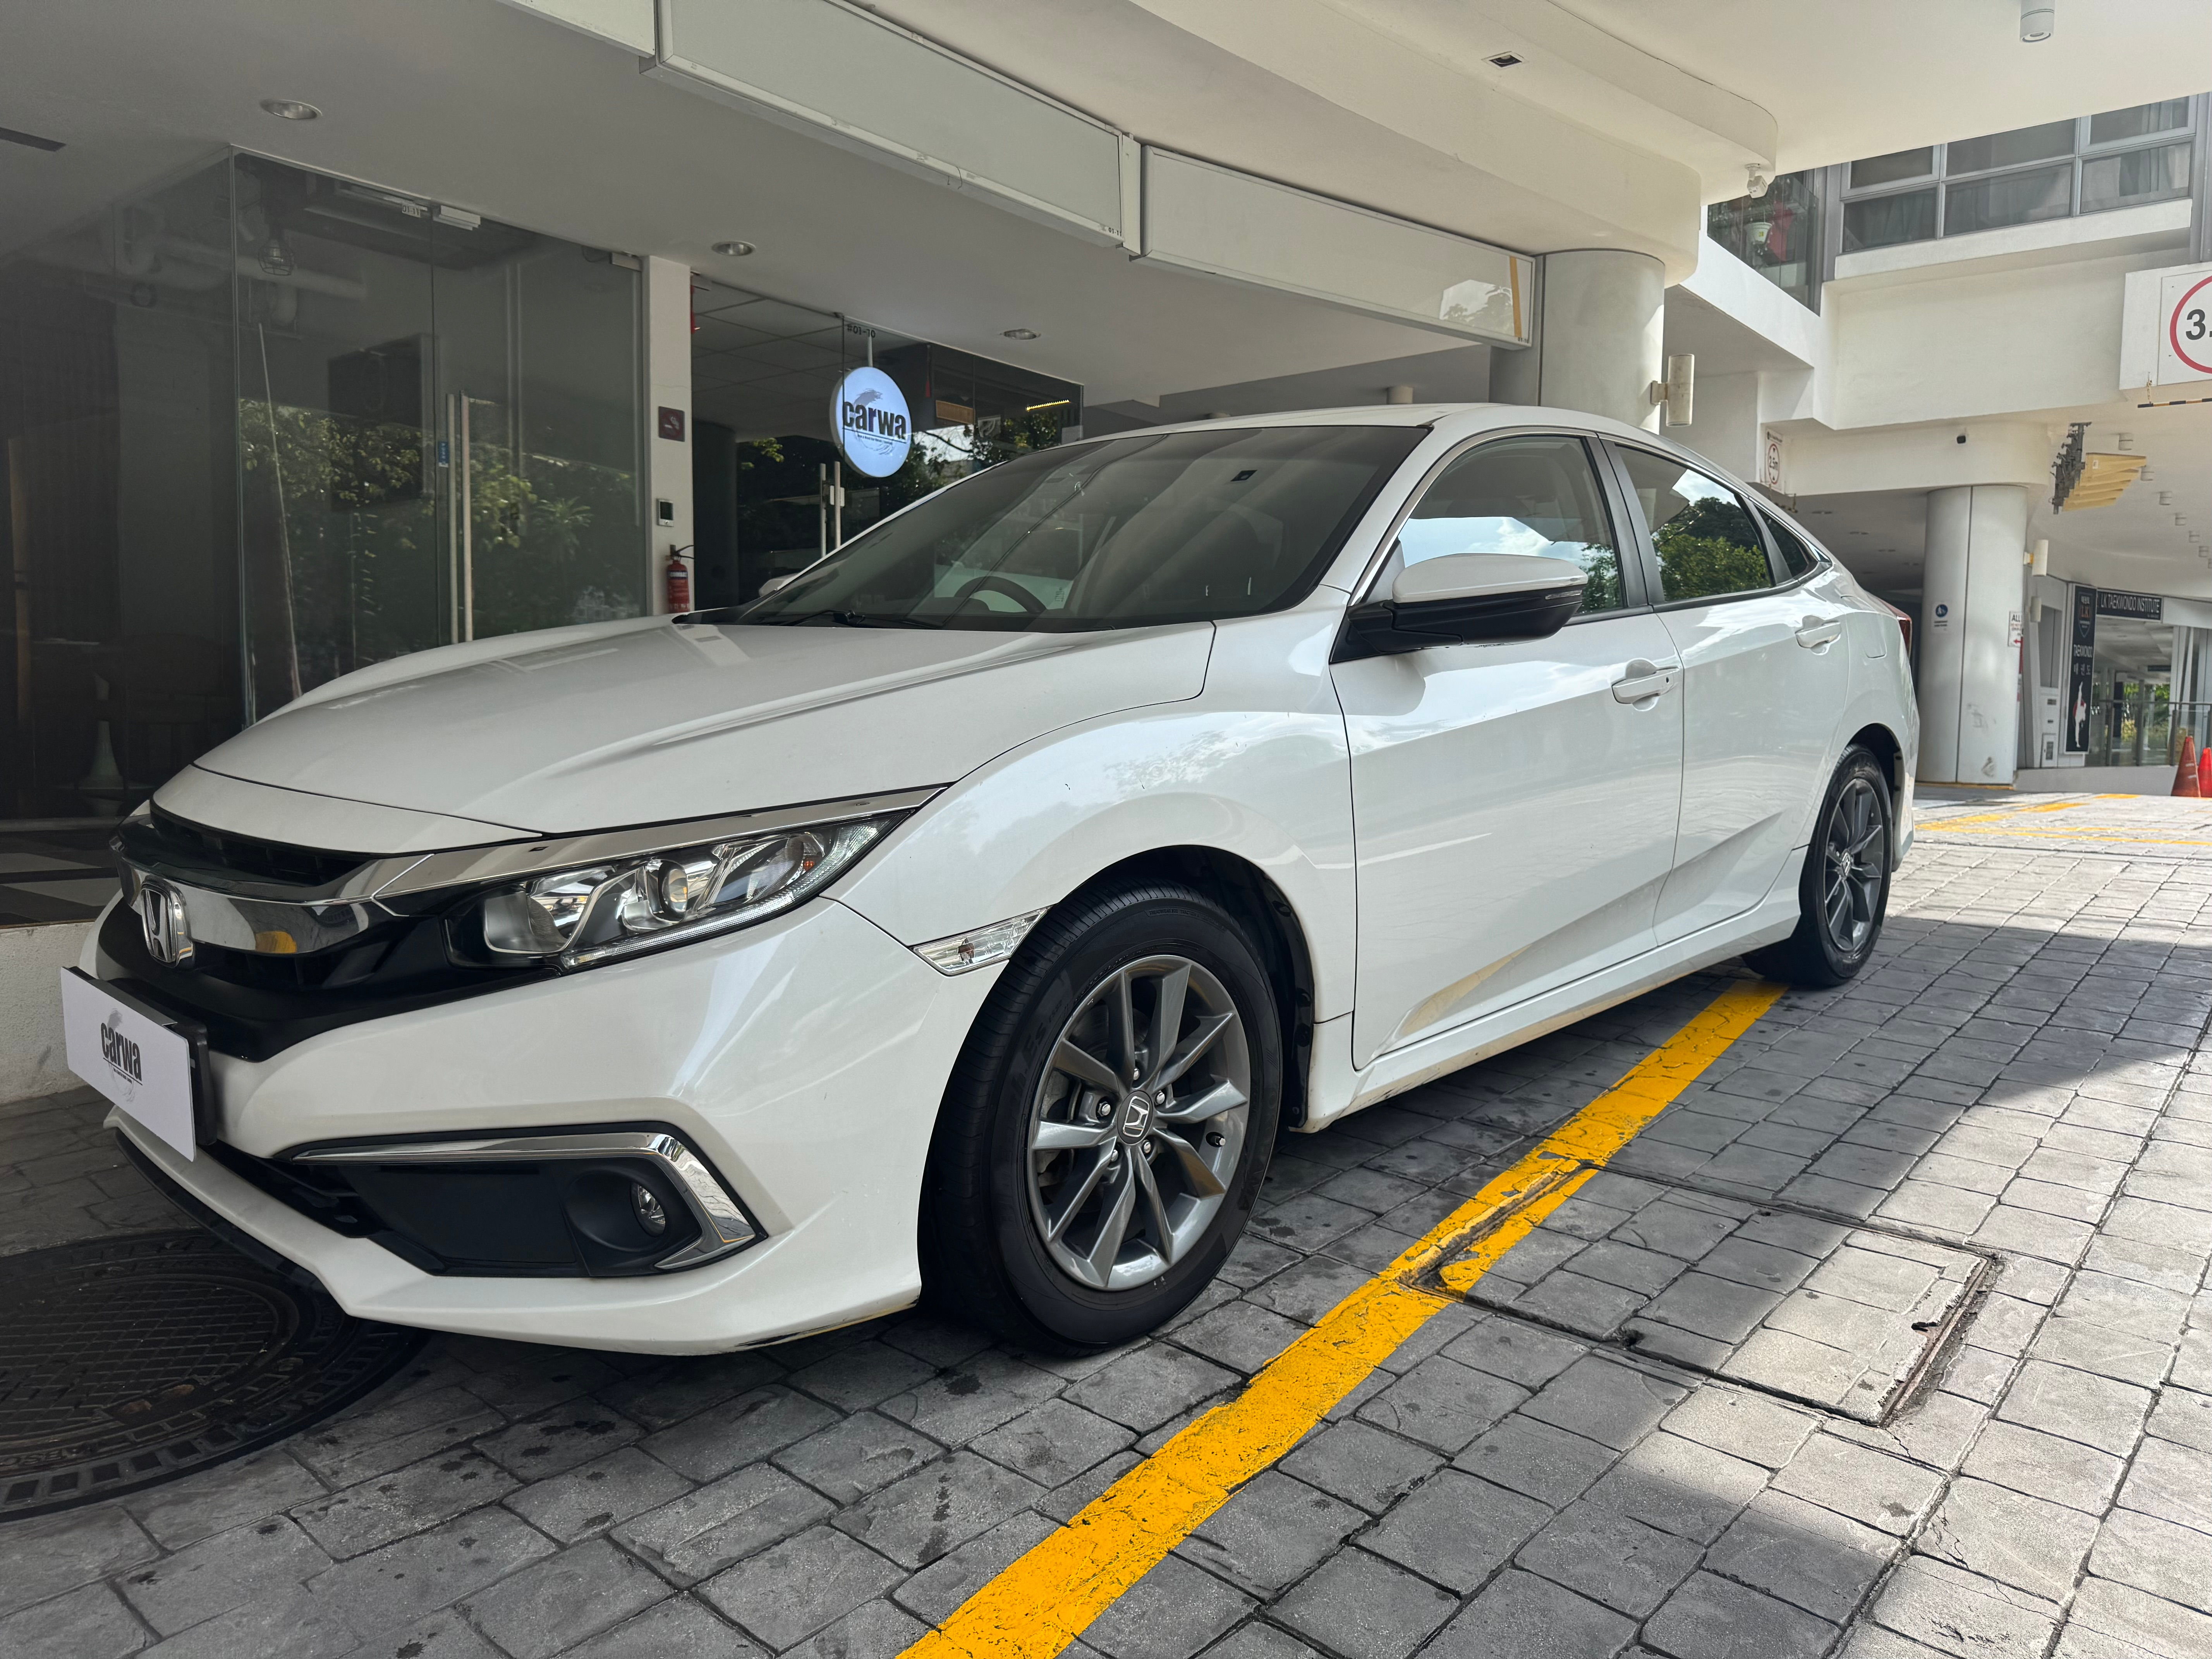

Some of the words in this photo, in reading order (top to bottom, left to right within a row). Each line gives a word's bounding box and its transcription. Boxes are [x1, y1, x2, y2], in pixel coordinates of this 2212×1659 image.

[847, 324, 876, 338] #01-10
[843, 401, 906, 441] carwa
[2101, 593, 2107, 608] LK
[2108, 594, 2137, 611] TAEKWONDO
[2137, 598, 2160, 613] INSTITUTE
[101, 1022, 142, 1082] carwa
